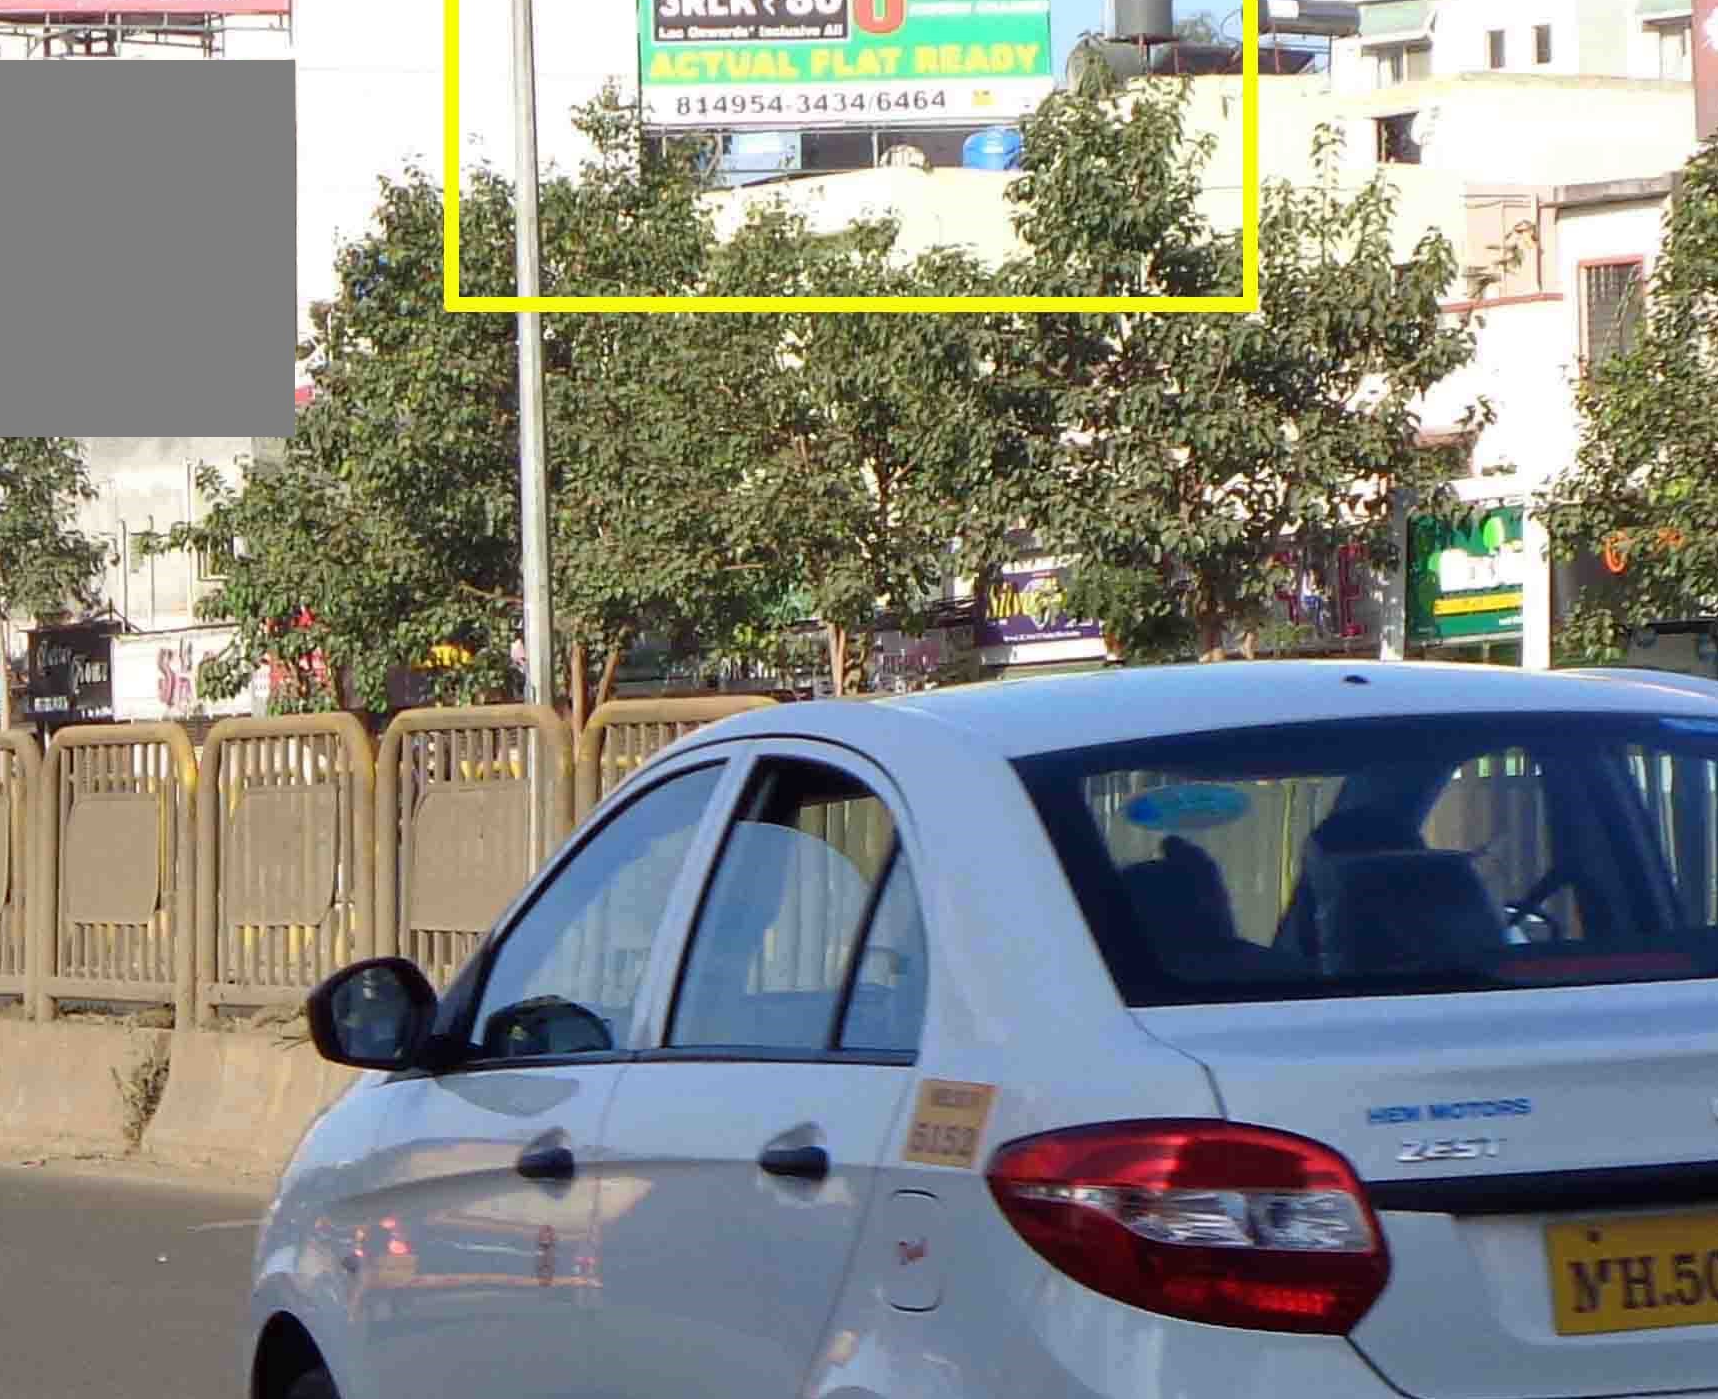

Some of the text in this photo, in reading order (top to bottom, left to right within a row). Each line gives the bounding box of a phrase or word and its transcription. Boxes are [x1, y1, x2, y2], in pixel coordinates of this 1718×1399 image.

[650, 44, 1039, 79] ACTUAL FLAT READY
[1367, 1097, 1532, 1124] HEM MOTORS
